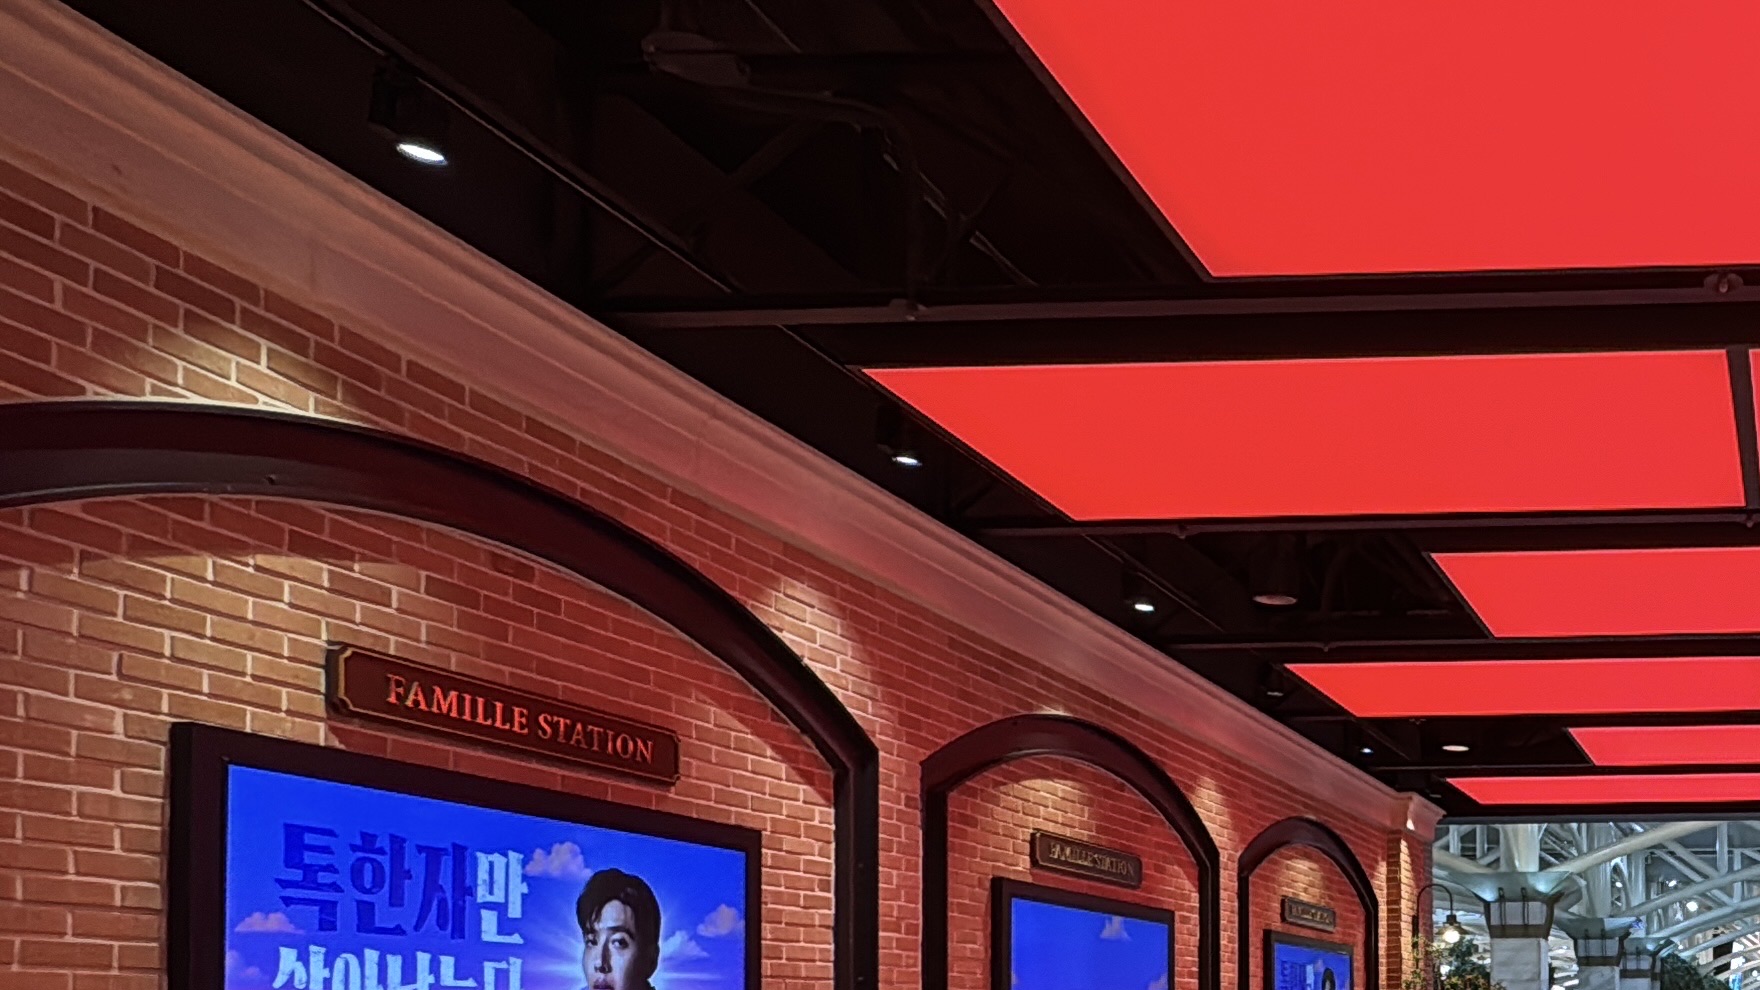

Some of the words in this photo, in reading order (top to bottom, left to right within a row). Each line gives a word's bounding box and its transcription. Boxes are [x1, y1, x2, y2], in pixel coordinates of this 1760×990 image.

[386, 673, 529, 735] FAMILLE
[537, 711, 654, 765] STATION
[273, 822, 529, 944] 톡한자만
